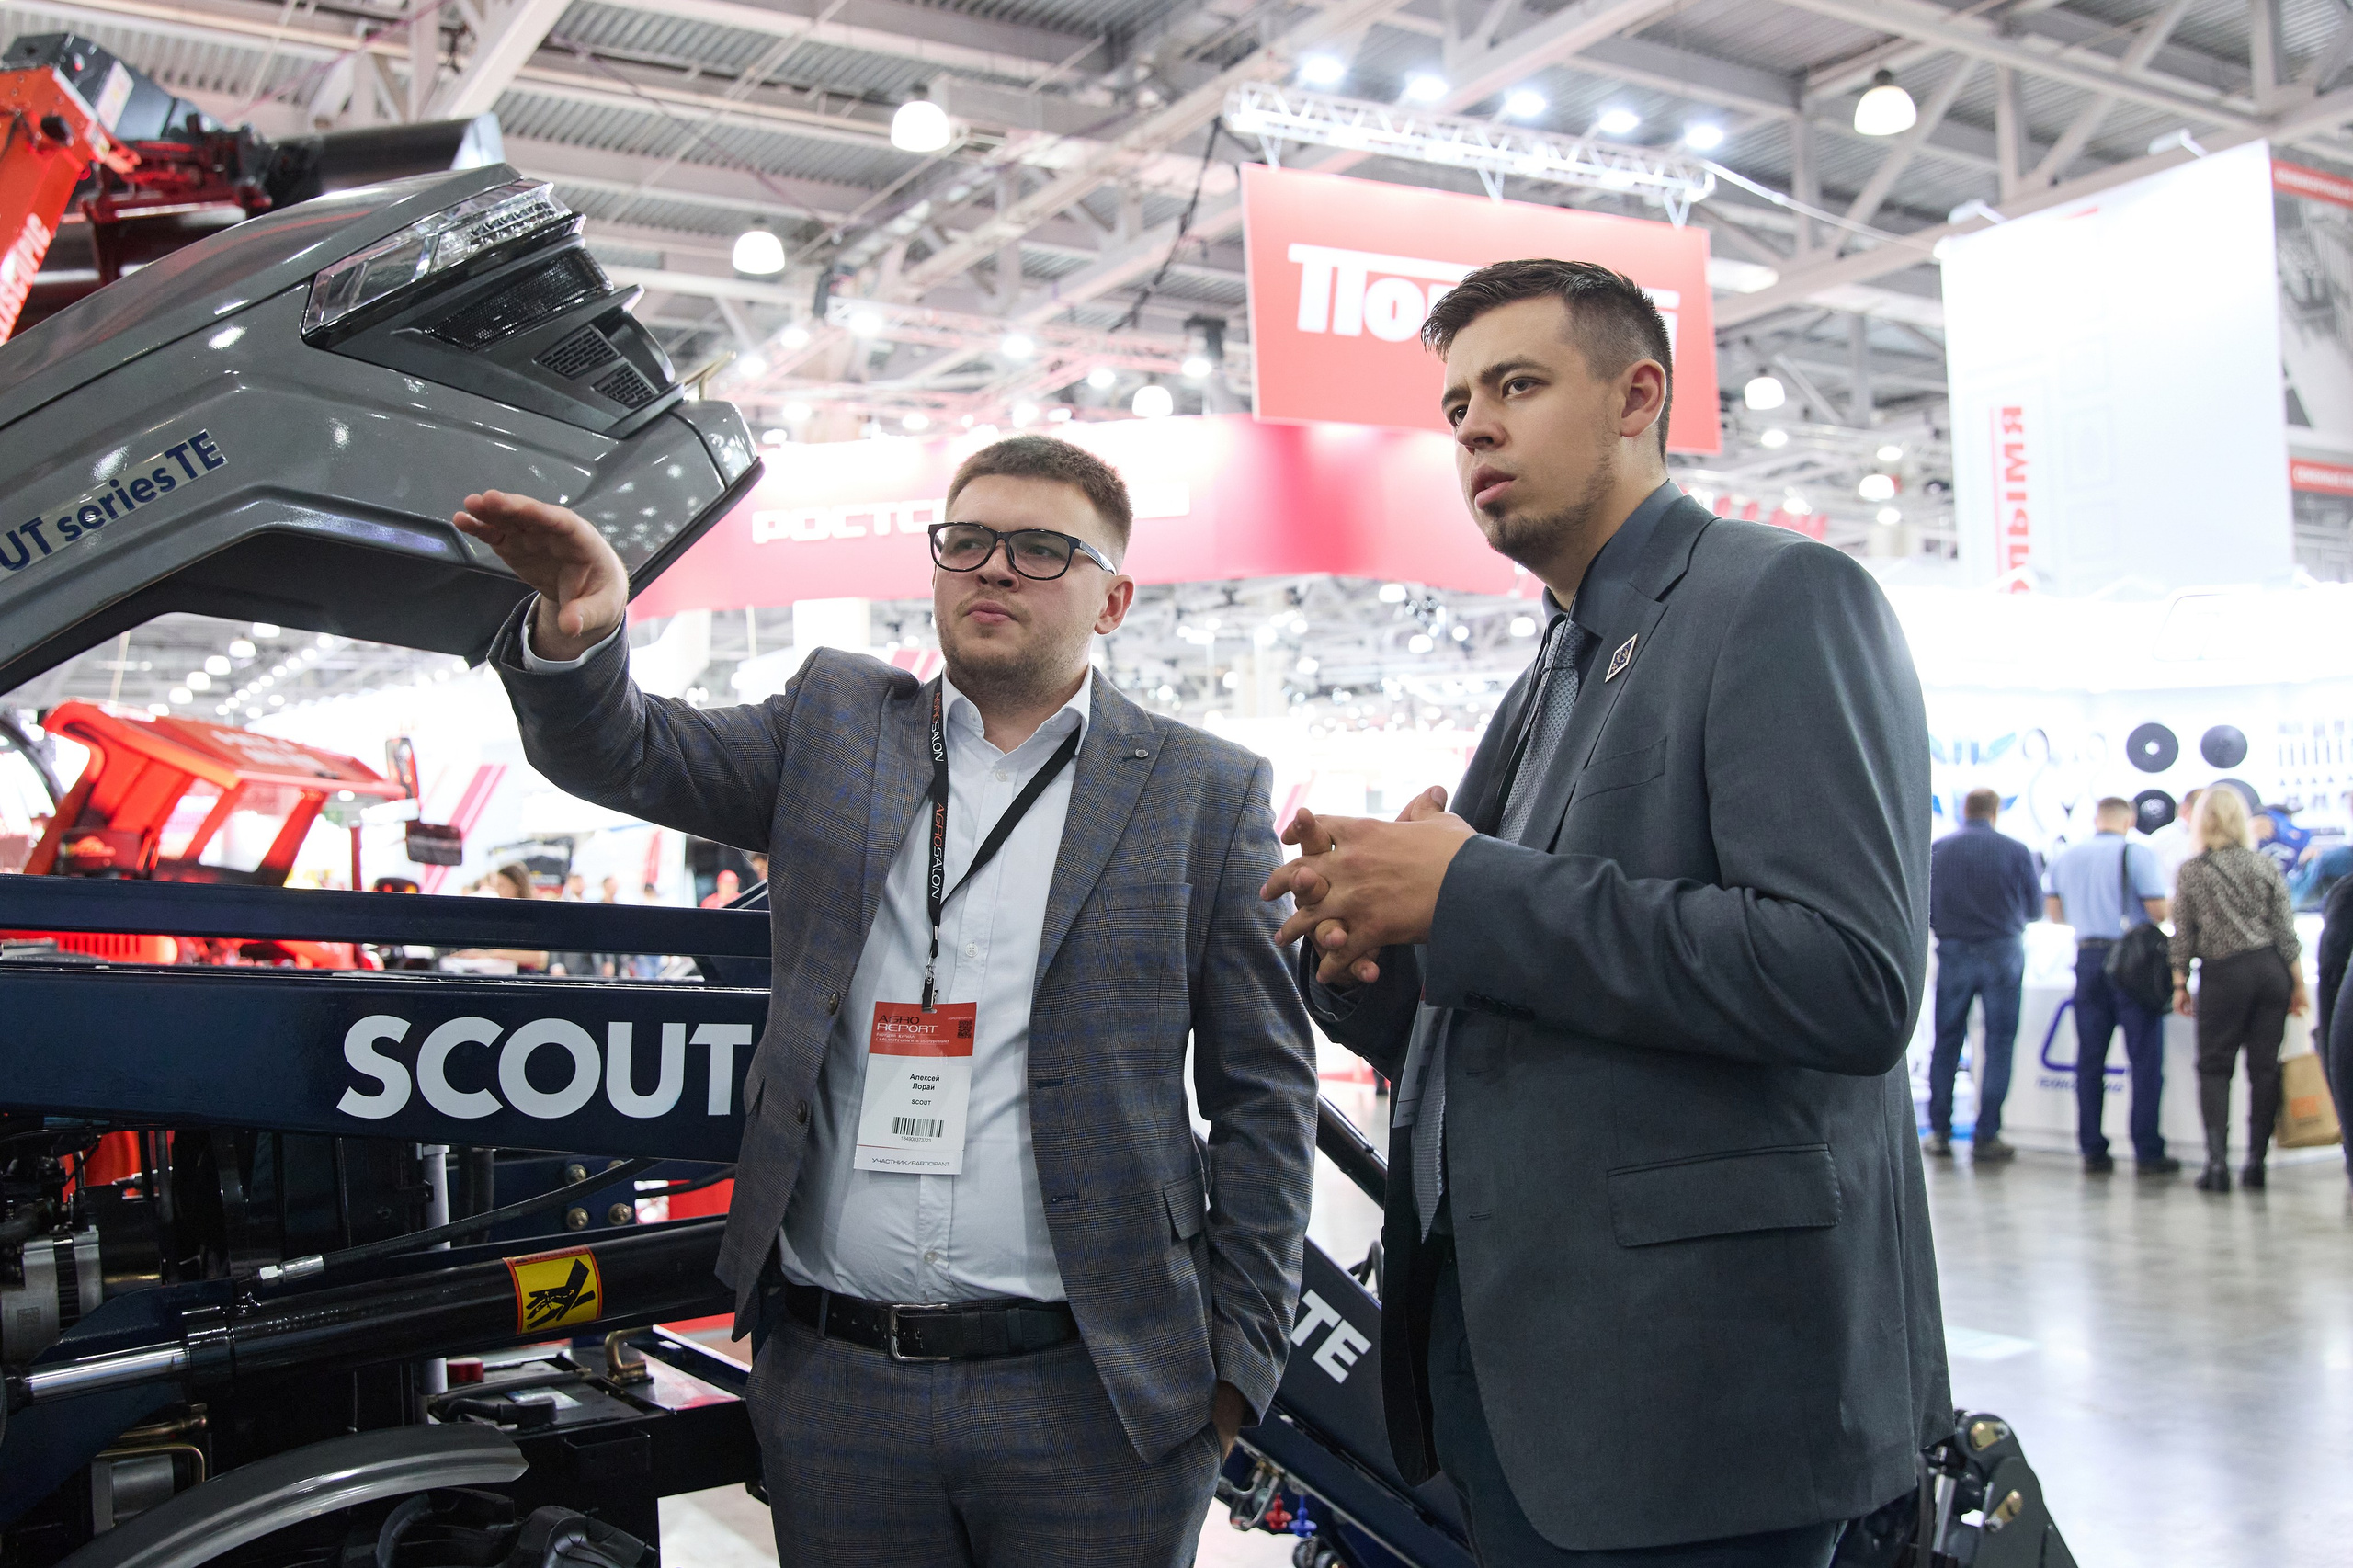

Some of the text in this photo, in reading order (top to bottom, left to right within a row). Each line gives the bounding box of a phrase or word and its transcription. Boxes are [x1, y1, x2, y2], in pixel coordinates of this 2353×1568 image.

[56, 467, 176, 542] series
[164, 431, 226, 480] TE
[931, 801, 946, 900] AGROSALON
[876, 1022, 938, 1034] REPORT
[878, 1015, 920, 1025] AGRO
[336, 1015, 753, 1119] SCOUT
[909, 1074, 940, 1082] Алексей
[912, 1083, 935, 1091] Лорай
[1290, 1289, 1372, 1384] TE
